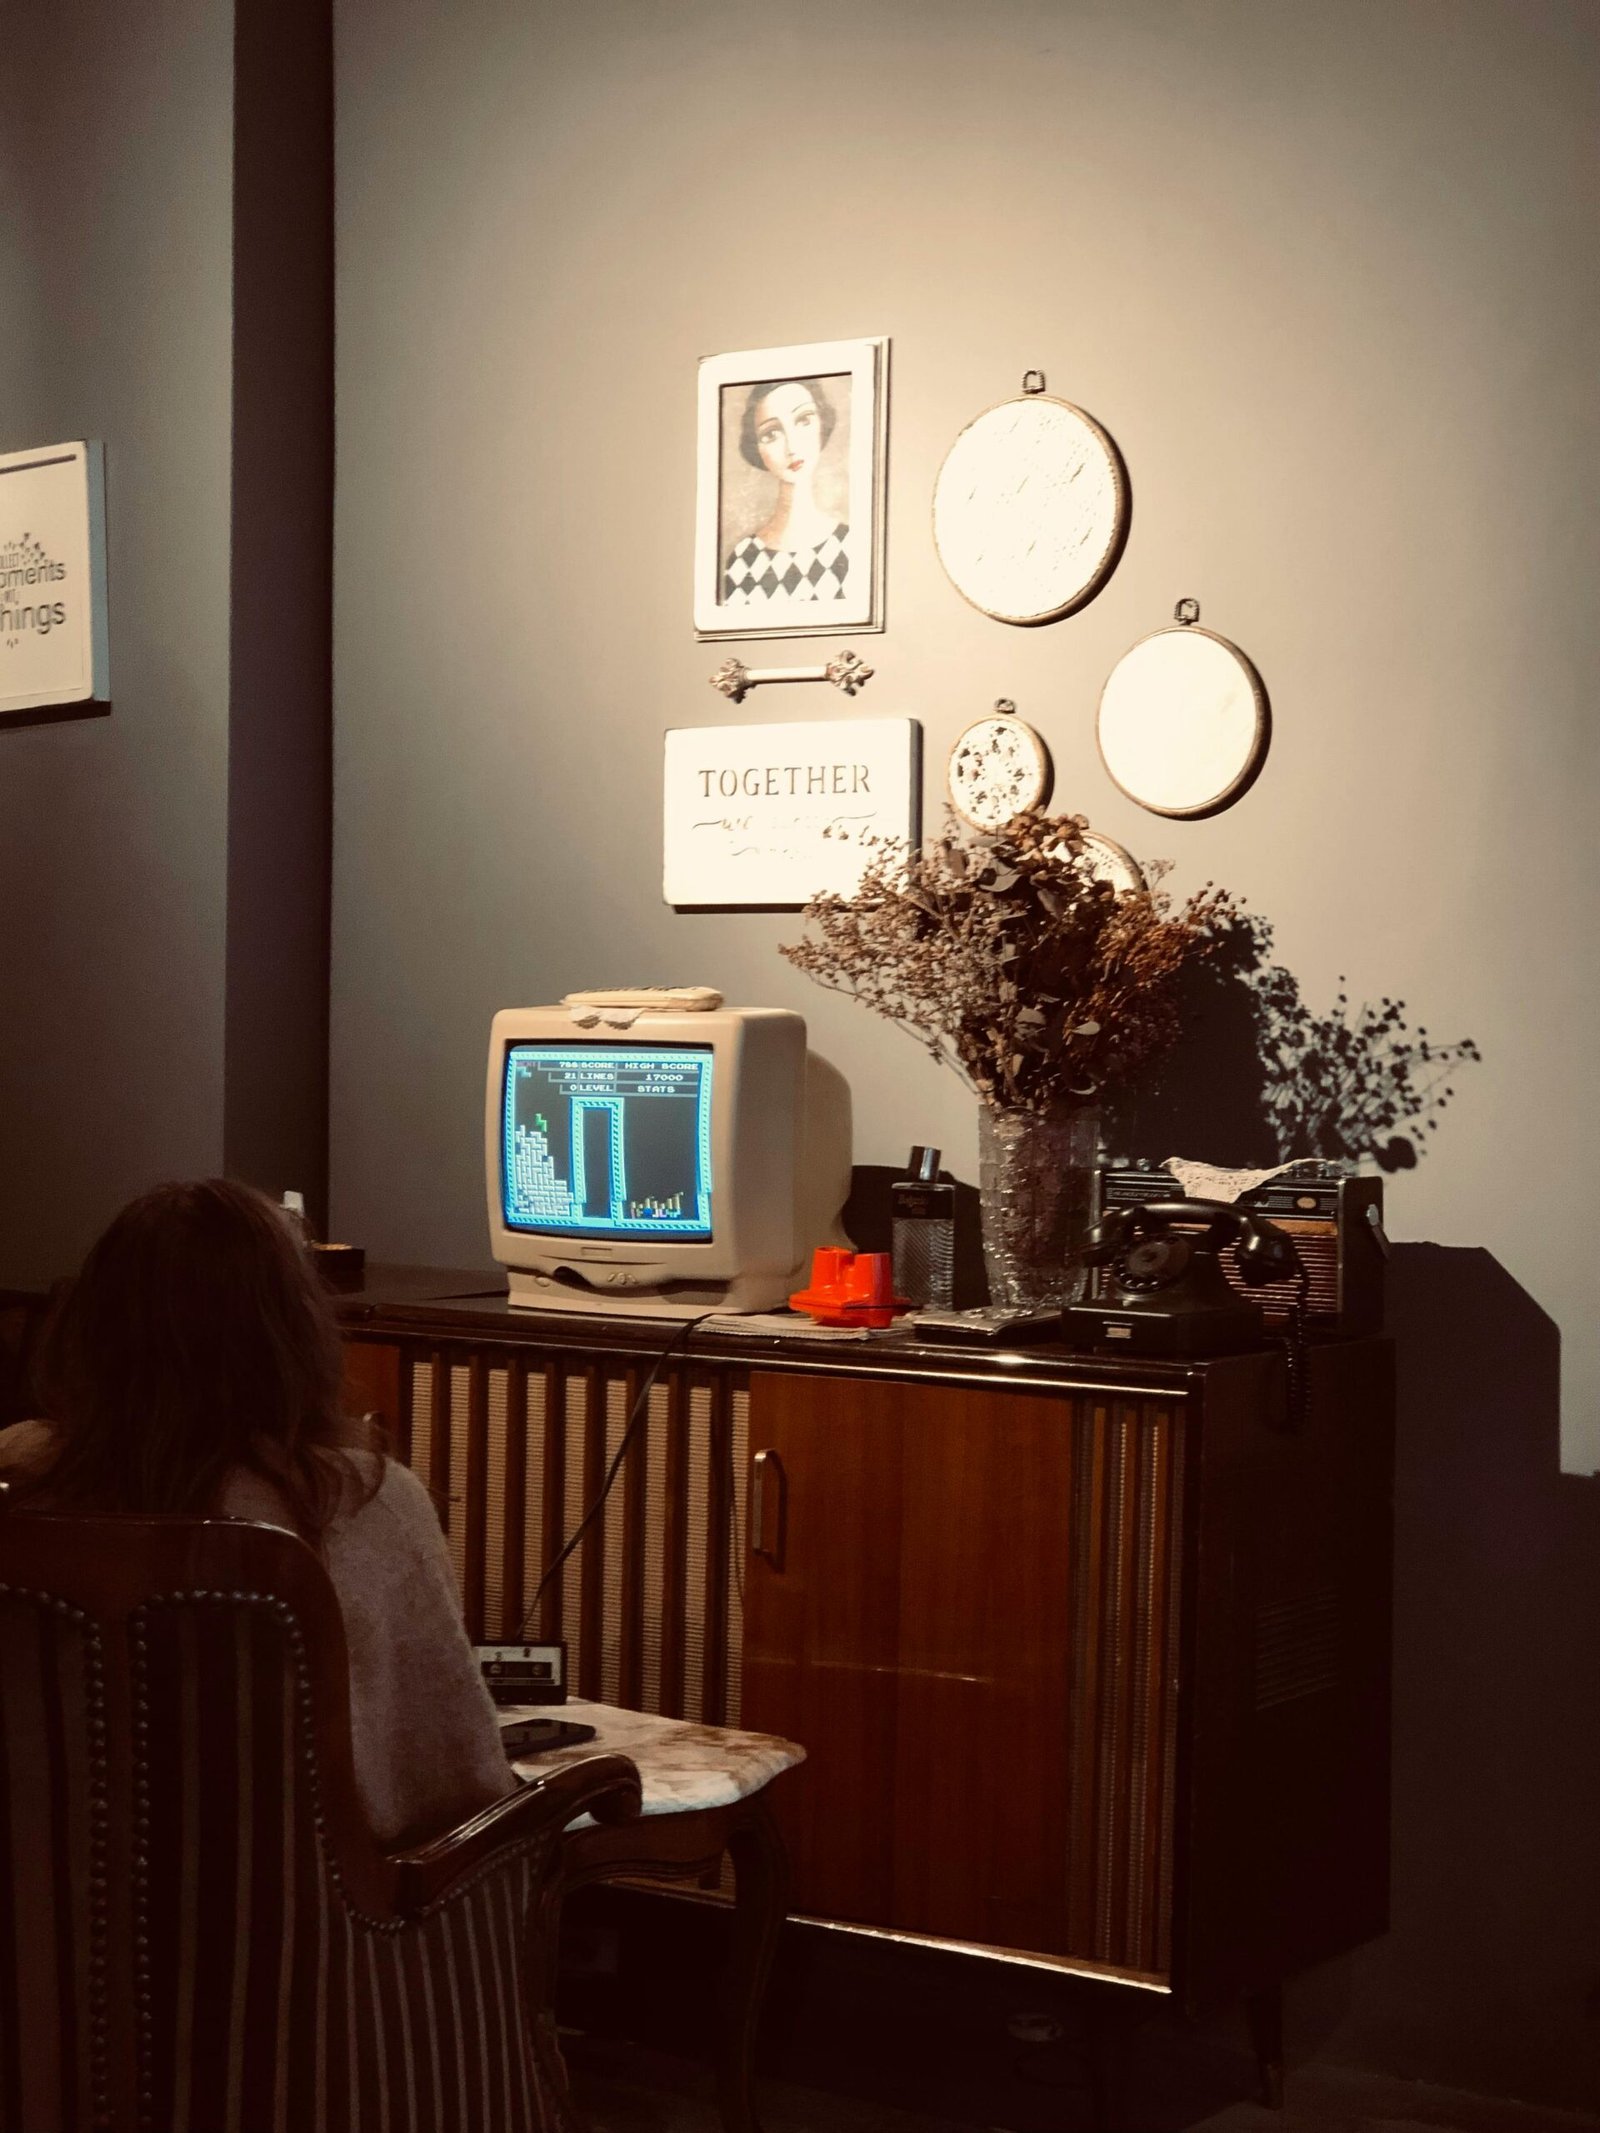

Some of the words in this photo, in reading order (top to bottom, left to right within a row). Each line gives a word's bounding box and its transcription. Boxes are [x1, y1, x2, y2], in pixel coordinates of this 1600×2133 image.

[698, 765, 871, 797] TOGETHER
[581, 1061, 615, 1069] SCORE
[661, 1062, 699, 1070] SCORE
[564, 1072, 577, 1080] 21
[580, 1072, 614, 1080] LINES
[579, 1084, 613, 1092] LEVEL
[637, 1085, 676, 1093] STATS
